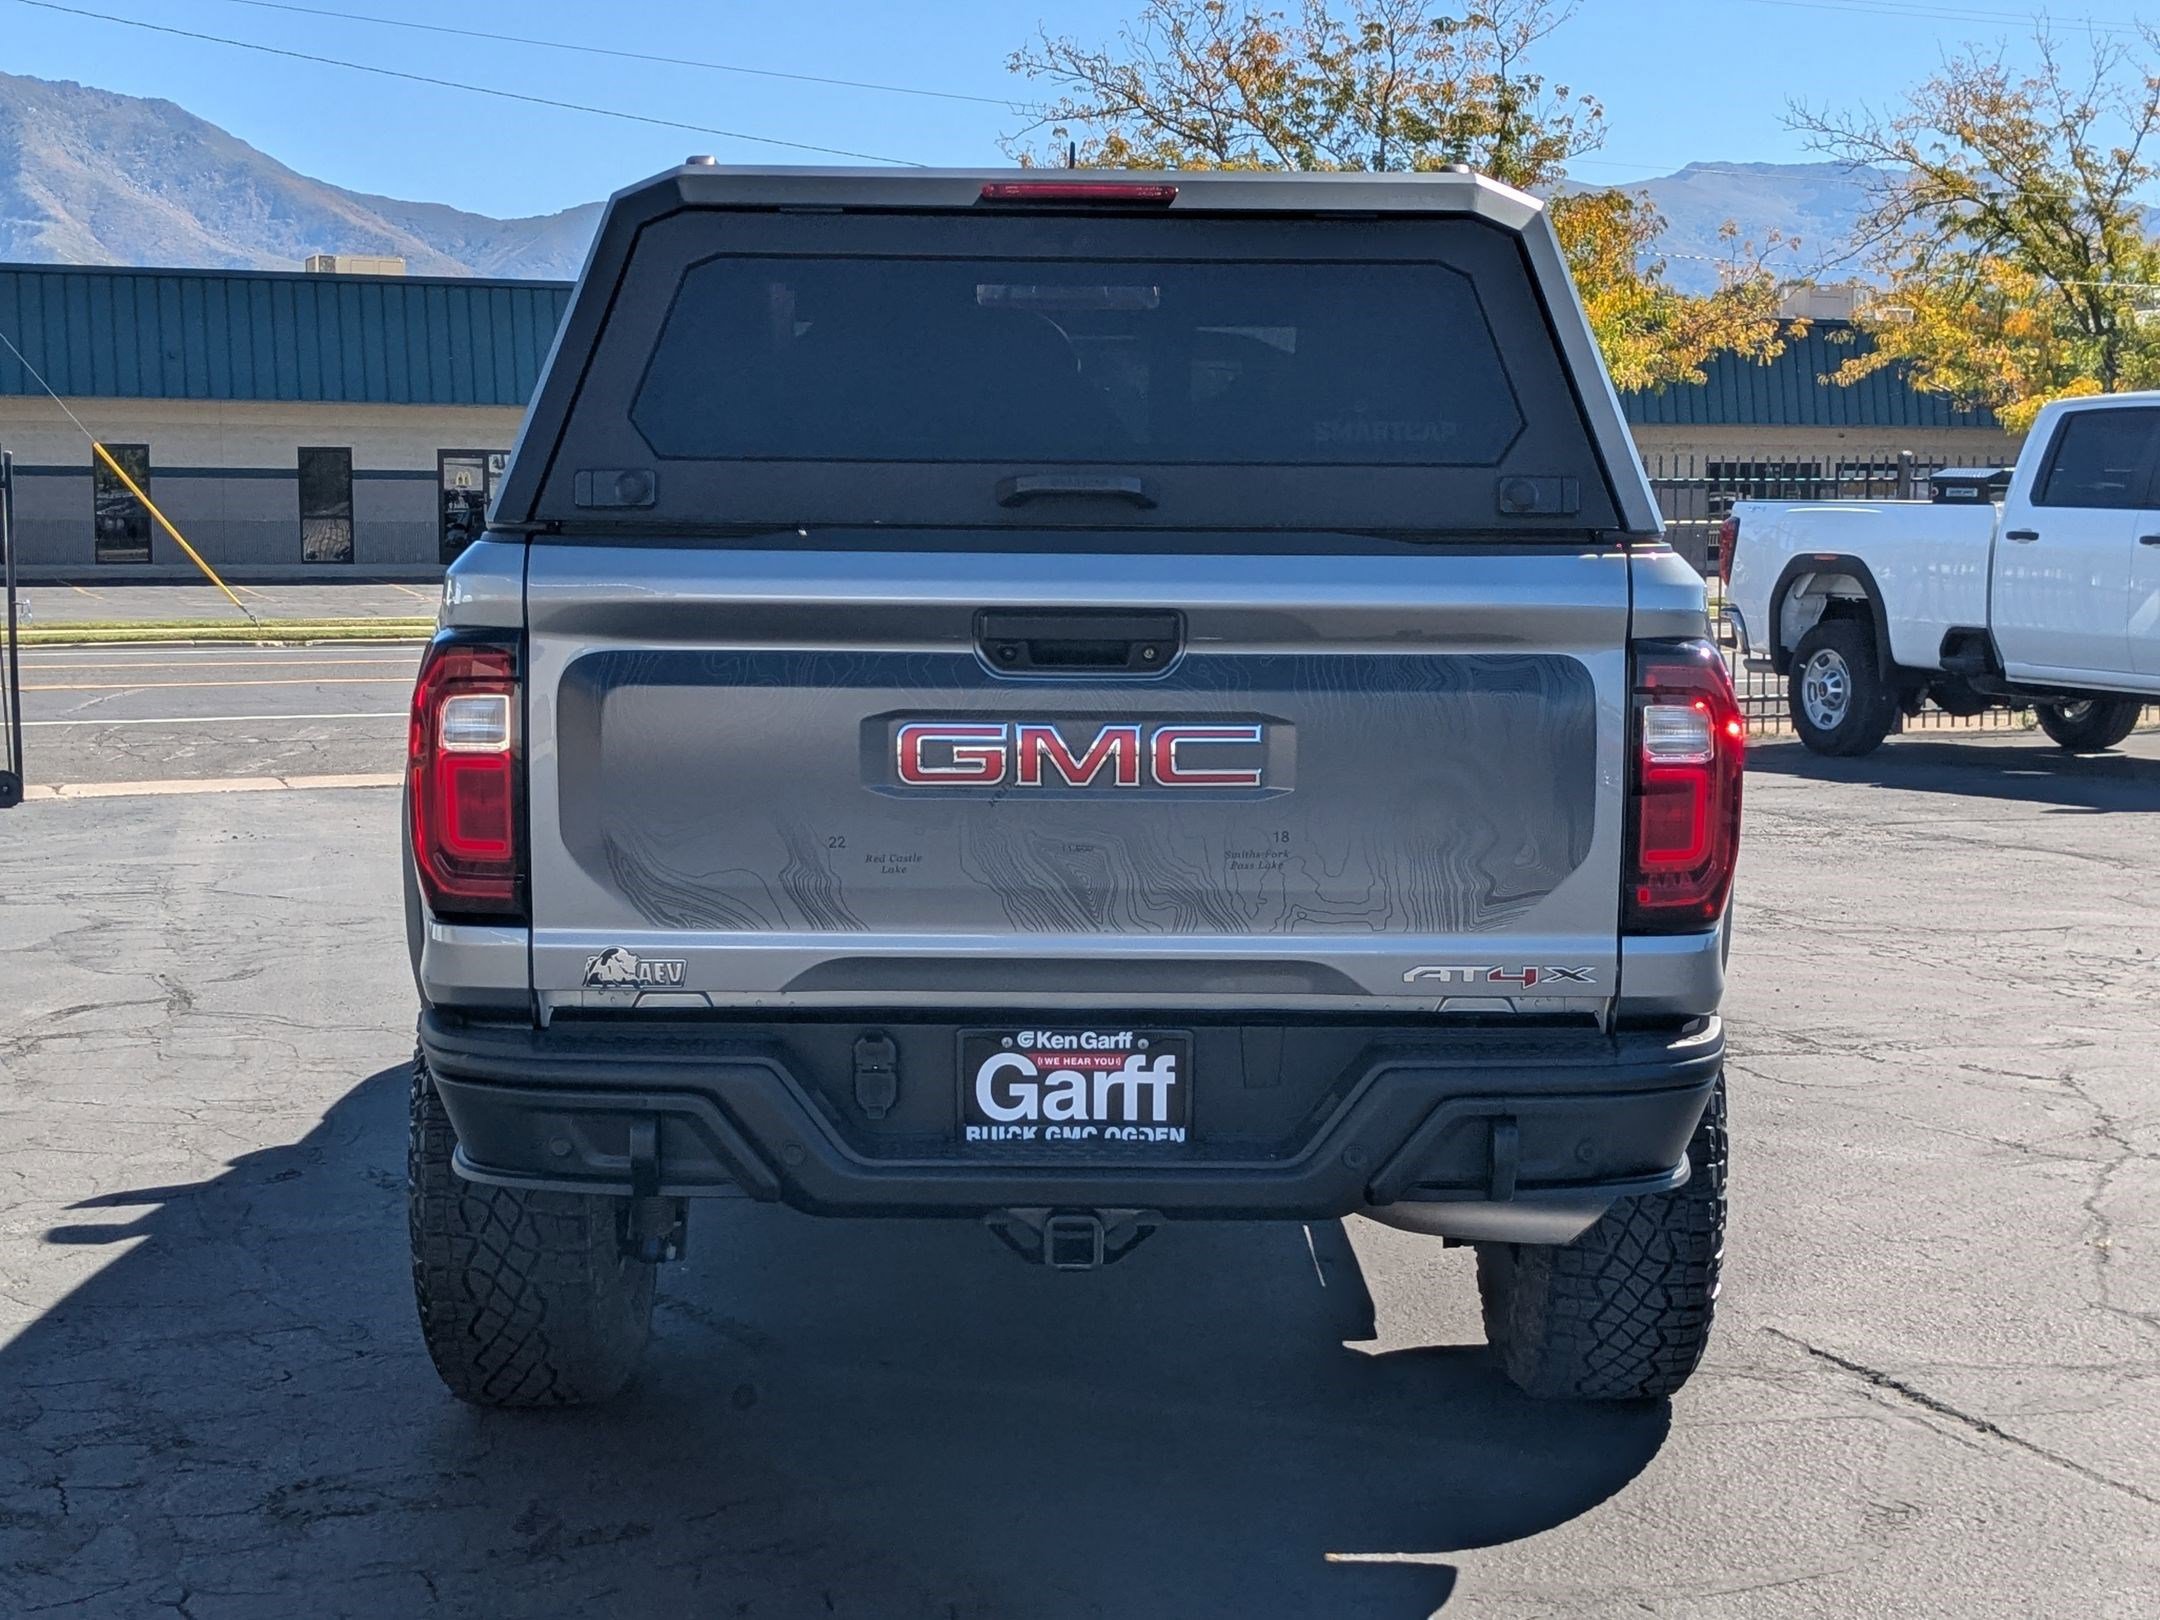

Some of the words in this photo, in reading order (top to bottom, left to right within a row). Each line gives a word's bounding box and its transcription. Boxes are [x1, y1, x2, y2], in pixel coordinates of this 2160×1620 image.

[896, 723, 1263, 787] GMC
[828, 835, 847, 849] 22
[1272, 830, 1290, 843] 18
[864, 853, 886, 864] Red
[888, 852, 923, 863] Castle
[881, 864, 907, 874] Lake
[639, 962, 683, 985] AEV
[1402, 965, 1599, 990] AT4X
[1036, 1031, 1078, 1049] Ken
[1080, 1031, 1134, 1049] Garff
[1044, 1057, 1061, 1066] WE
[1063, 1057, 1091, 1066] HEAR
[1094, 1057, 1116, 1066] YOU
[976, 1052, 1176, 1122] Garff
